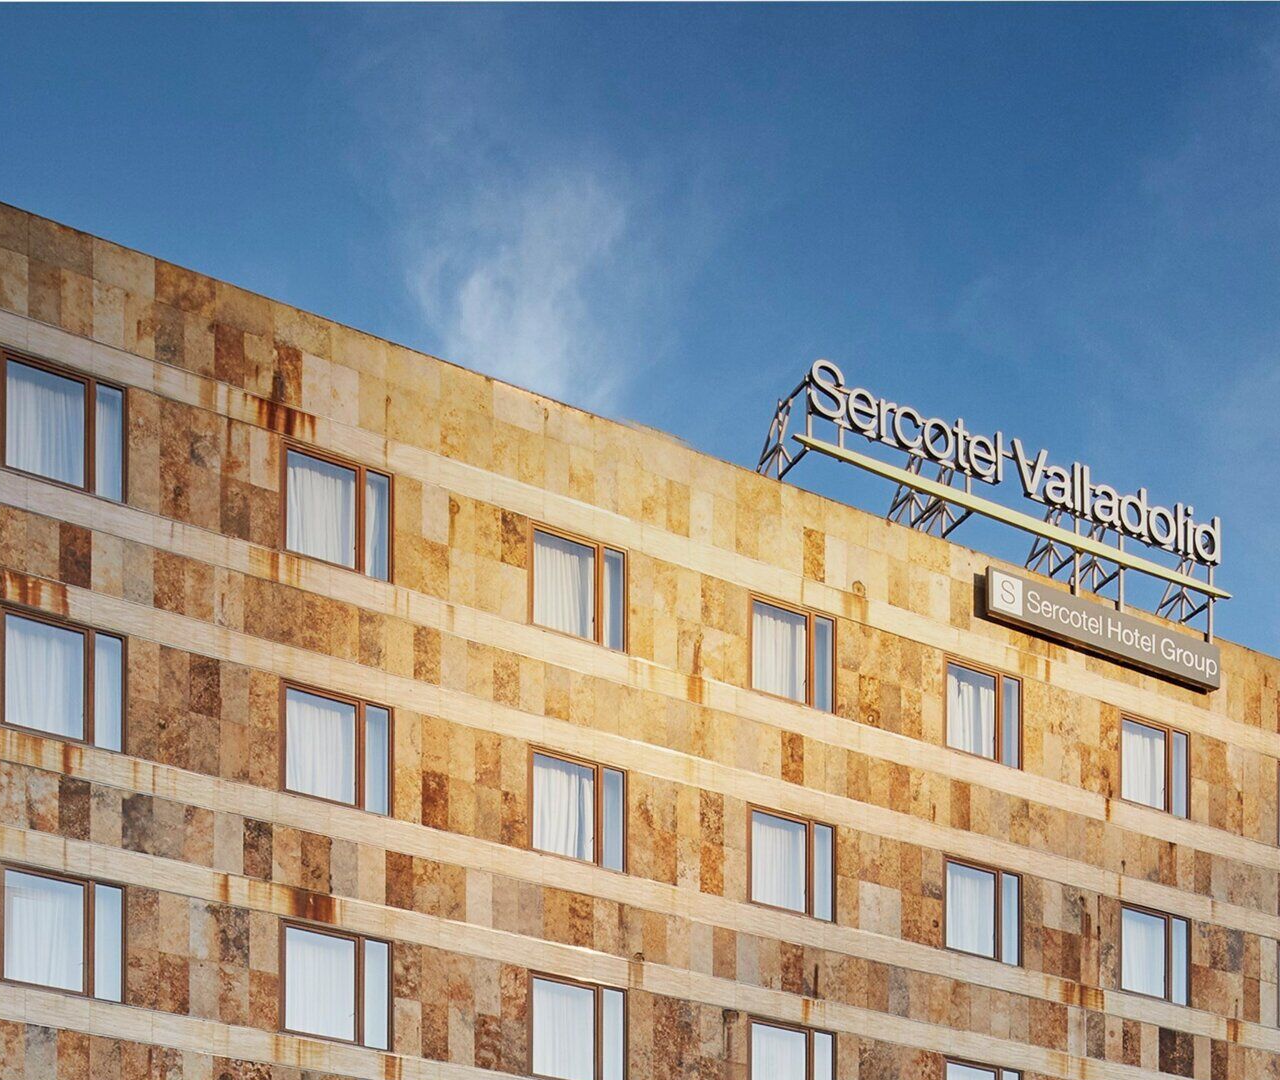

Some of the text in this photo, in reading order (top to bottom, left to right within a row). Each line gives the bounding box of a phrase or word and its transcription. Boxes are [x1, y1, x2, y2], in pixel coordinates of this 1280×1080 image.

[809, 359, 1221, 567] Sercotel Valladolid
[1000, 578, 1218, 678] S Sercotel Hotel Group
